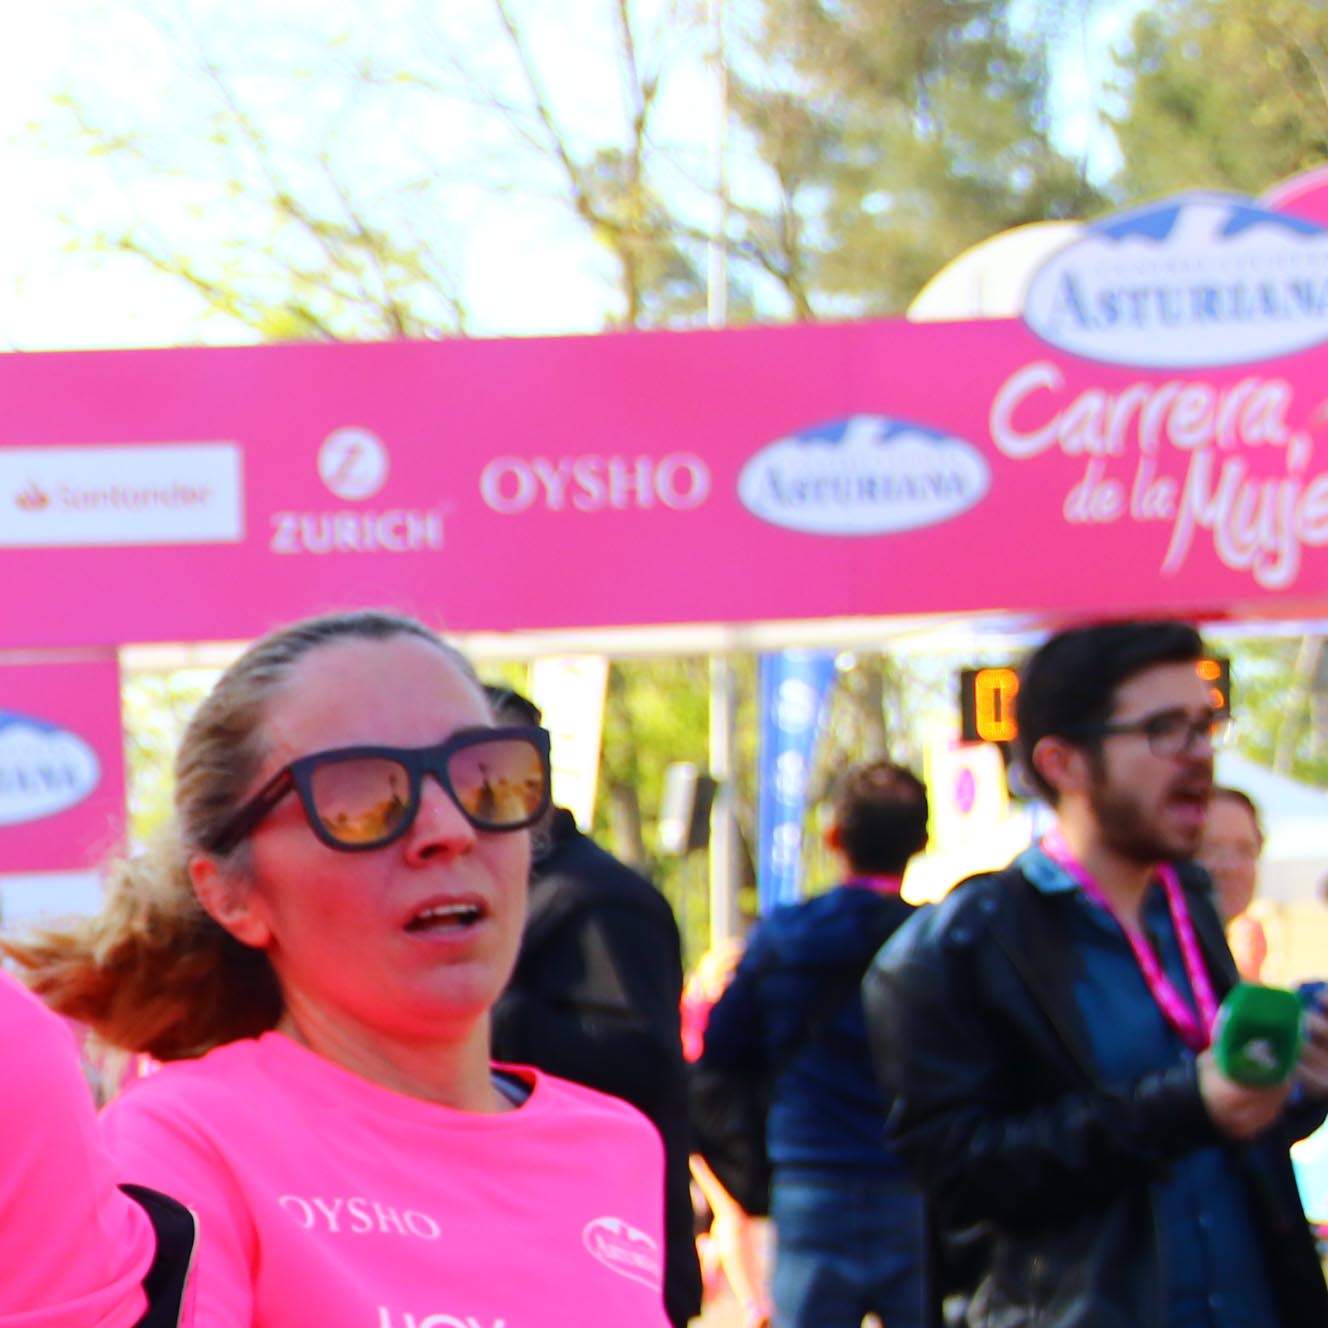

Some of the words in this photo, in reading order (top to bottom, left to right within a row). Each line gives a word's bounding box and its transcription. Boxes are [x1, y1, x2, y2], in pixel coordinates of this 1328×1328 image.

[1050, 272, 1328, 329] ASTURIAN
[990, 362, 1292, 459] Carrera
[54, 479, 212, 512] Santander
[479, 455, 711, 514] OYSHO
[763, 469, 970, 507] ASTURIANA
[271, 511, 443, 554] ZURICH
[1064, 460, 1124, 522] de
[1130, 458, 1175, 519] la
[1162, 436, 1328, 589] Muje
[279, 1195, 441, 1240] OYSHO
